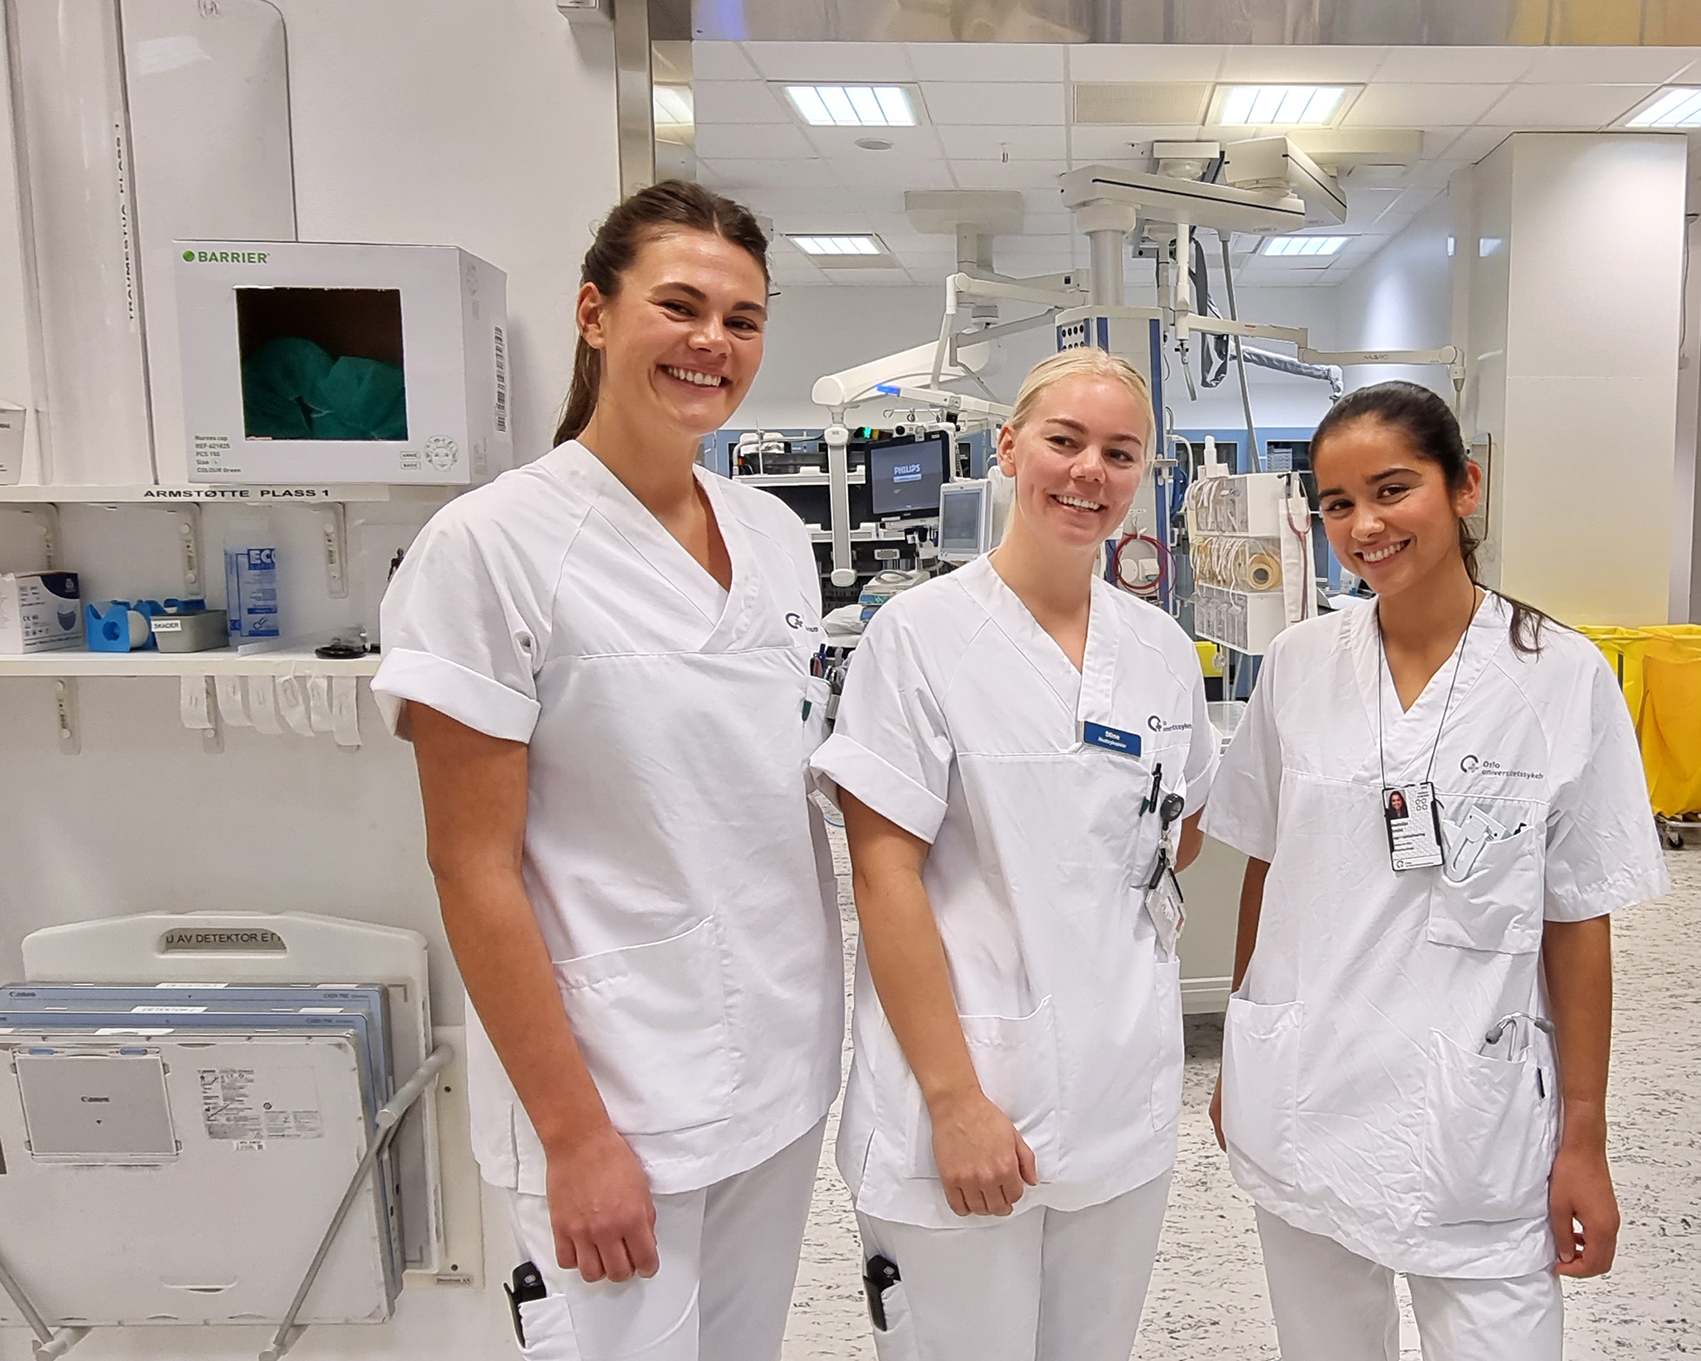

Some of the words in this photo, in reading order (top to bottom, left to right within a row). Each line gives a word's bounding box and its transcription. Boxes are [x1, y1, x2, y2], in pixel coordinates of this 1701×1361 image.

[198, 251, 268, 263] BARRIER
[894, 464, 920, 474] PHILIPS
[143, 489, 250, 498] ARMSTØTTE
[260, 489, 317, 498] PLASS
[321, 489, 330, 497] 1
[1482, 760, 1501, 769] Oslo
[176, 935, 193, 943] AV
[195, 933, 258, 944] DETEKTOR
